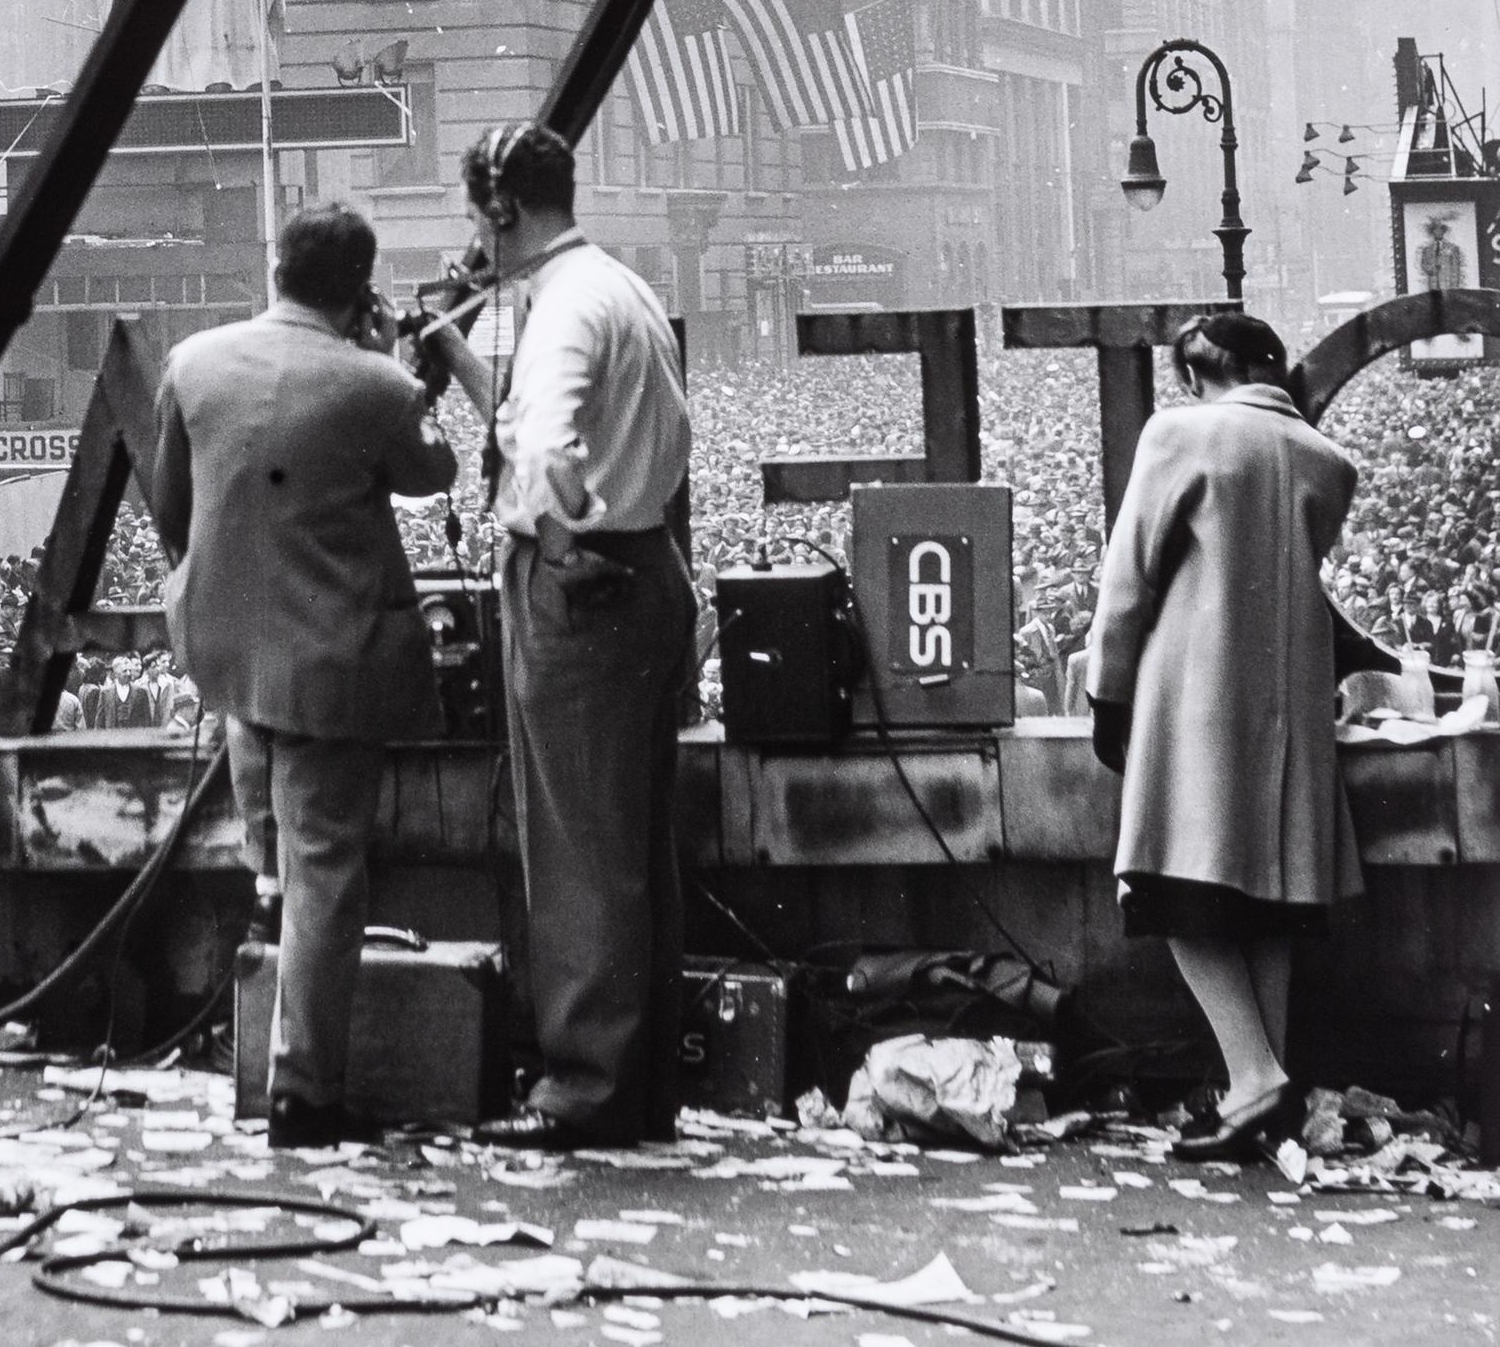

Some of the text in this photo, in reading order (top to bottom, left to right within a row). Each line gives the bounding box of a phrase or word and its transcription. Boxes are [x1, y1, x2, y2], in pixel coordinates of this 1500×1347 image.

[833, 255, 863, 265] BAR
[814, 263, 894, 275] ESTAURANT
[909, 540, 952, 667] CBS
